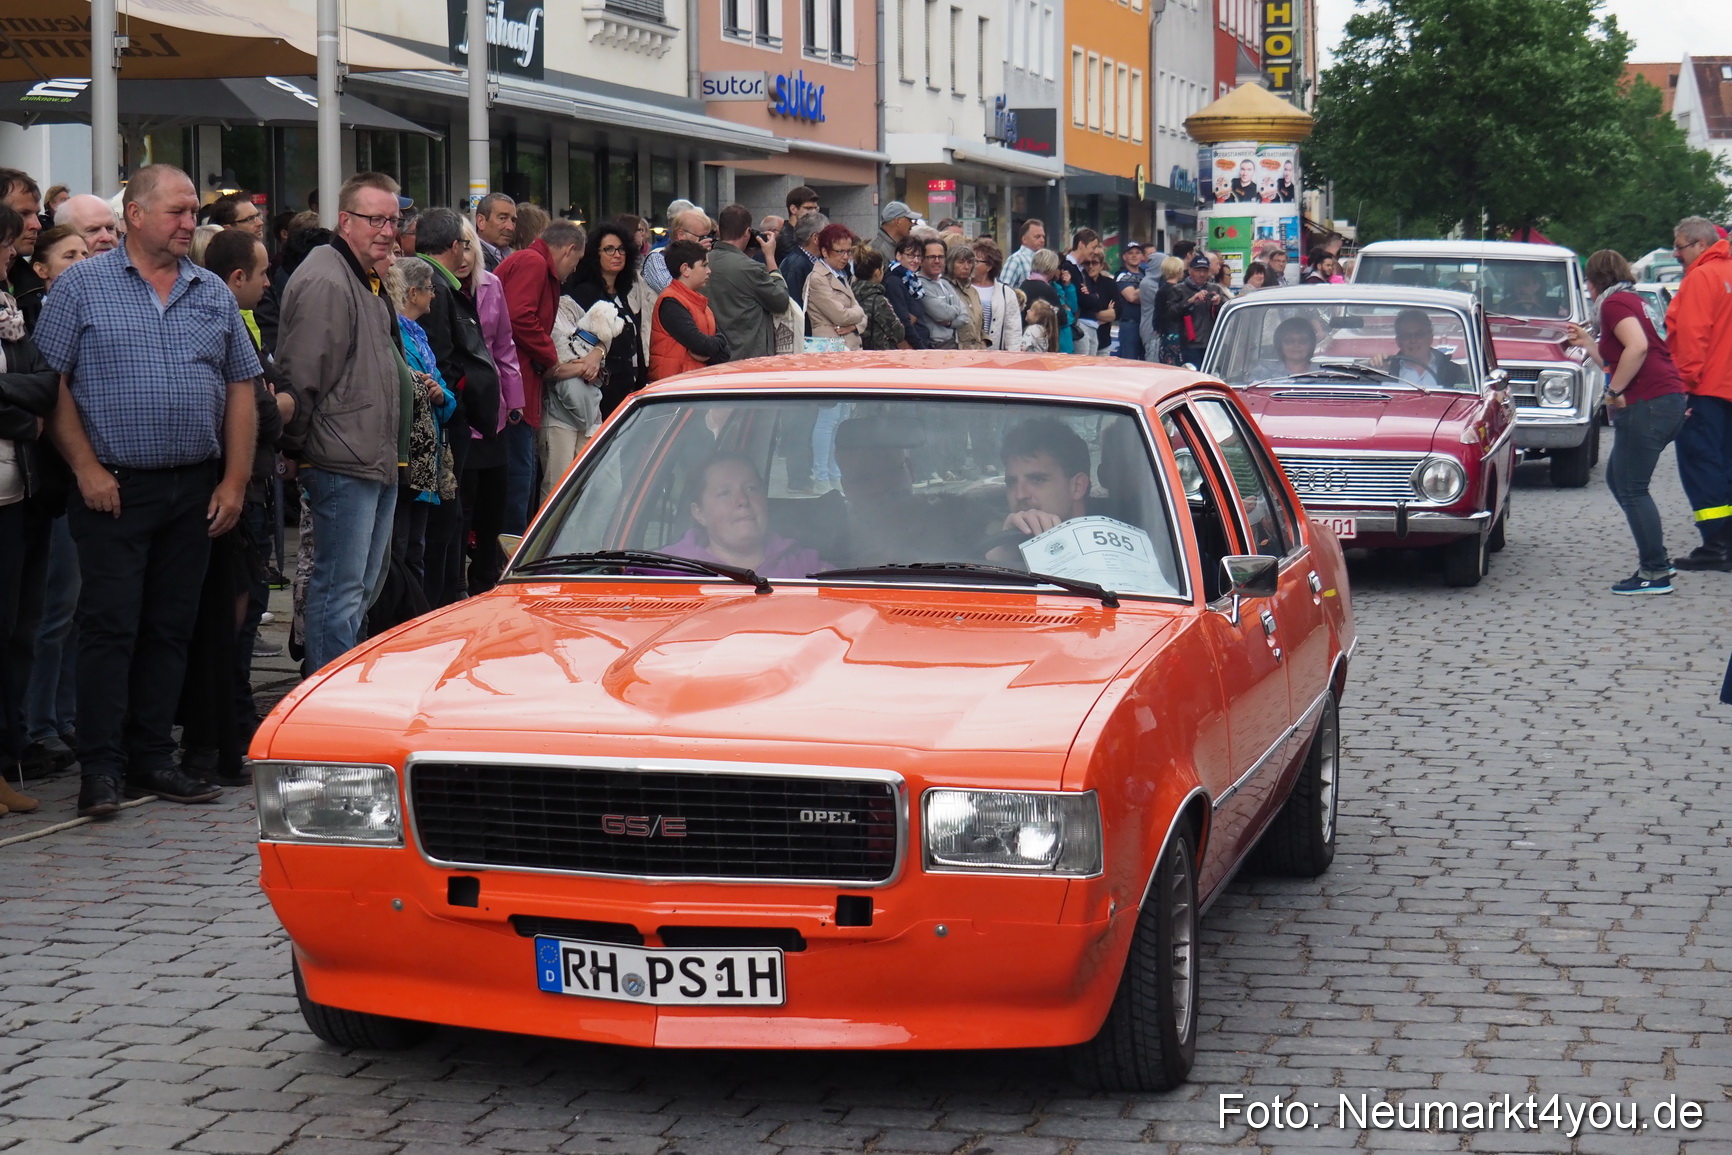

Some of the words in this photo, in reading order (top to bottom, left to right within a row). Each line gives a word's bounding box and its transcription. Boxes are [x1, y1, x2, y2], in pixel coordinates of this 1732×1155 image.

[19, 95, 73, 103] drinknow.de
[1093, 531, 1135, 552] 585
[601, 813, 688, 838] GS/E
[800, 809, 856, 824] OPEL
[545, 969, 555, 983] D
[562, 946, 619, 993] RH
